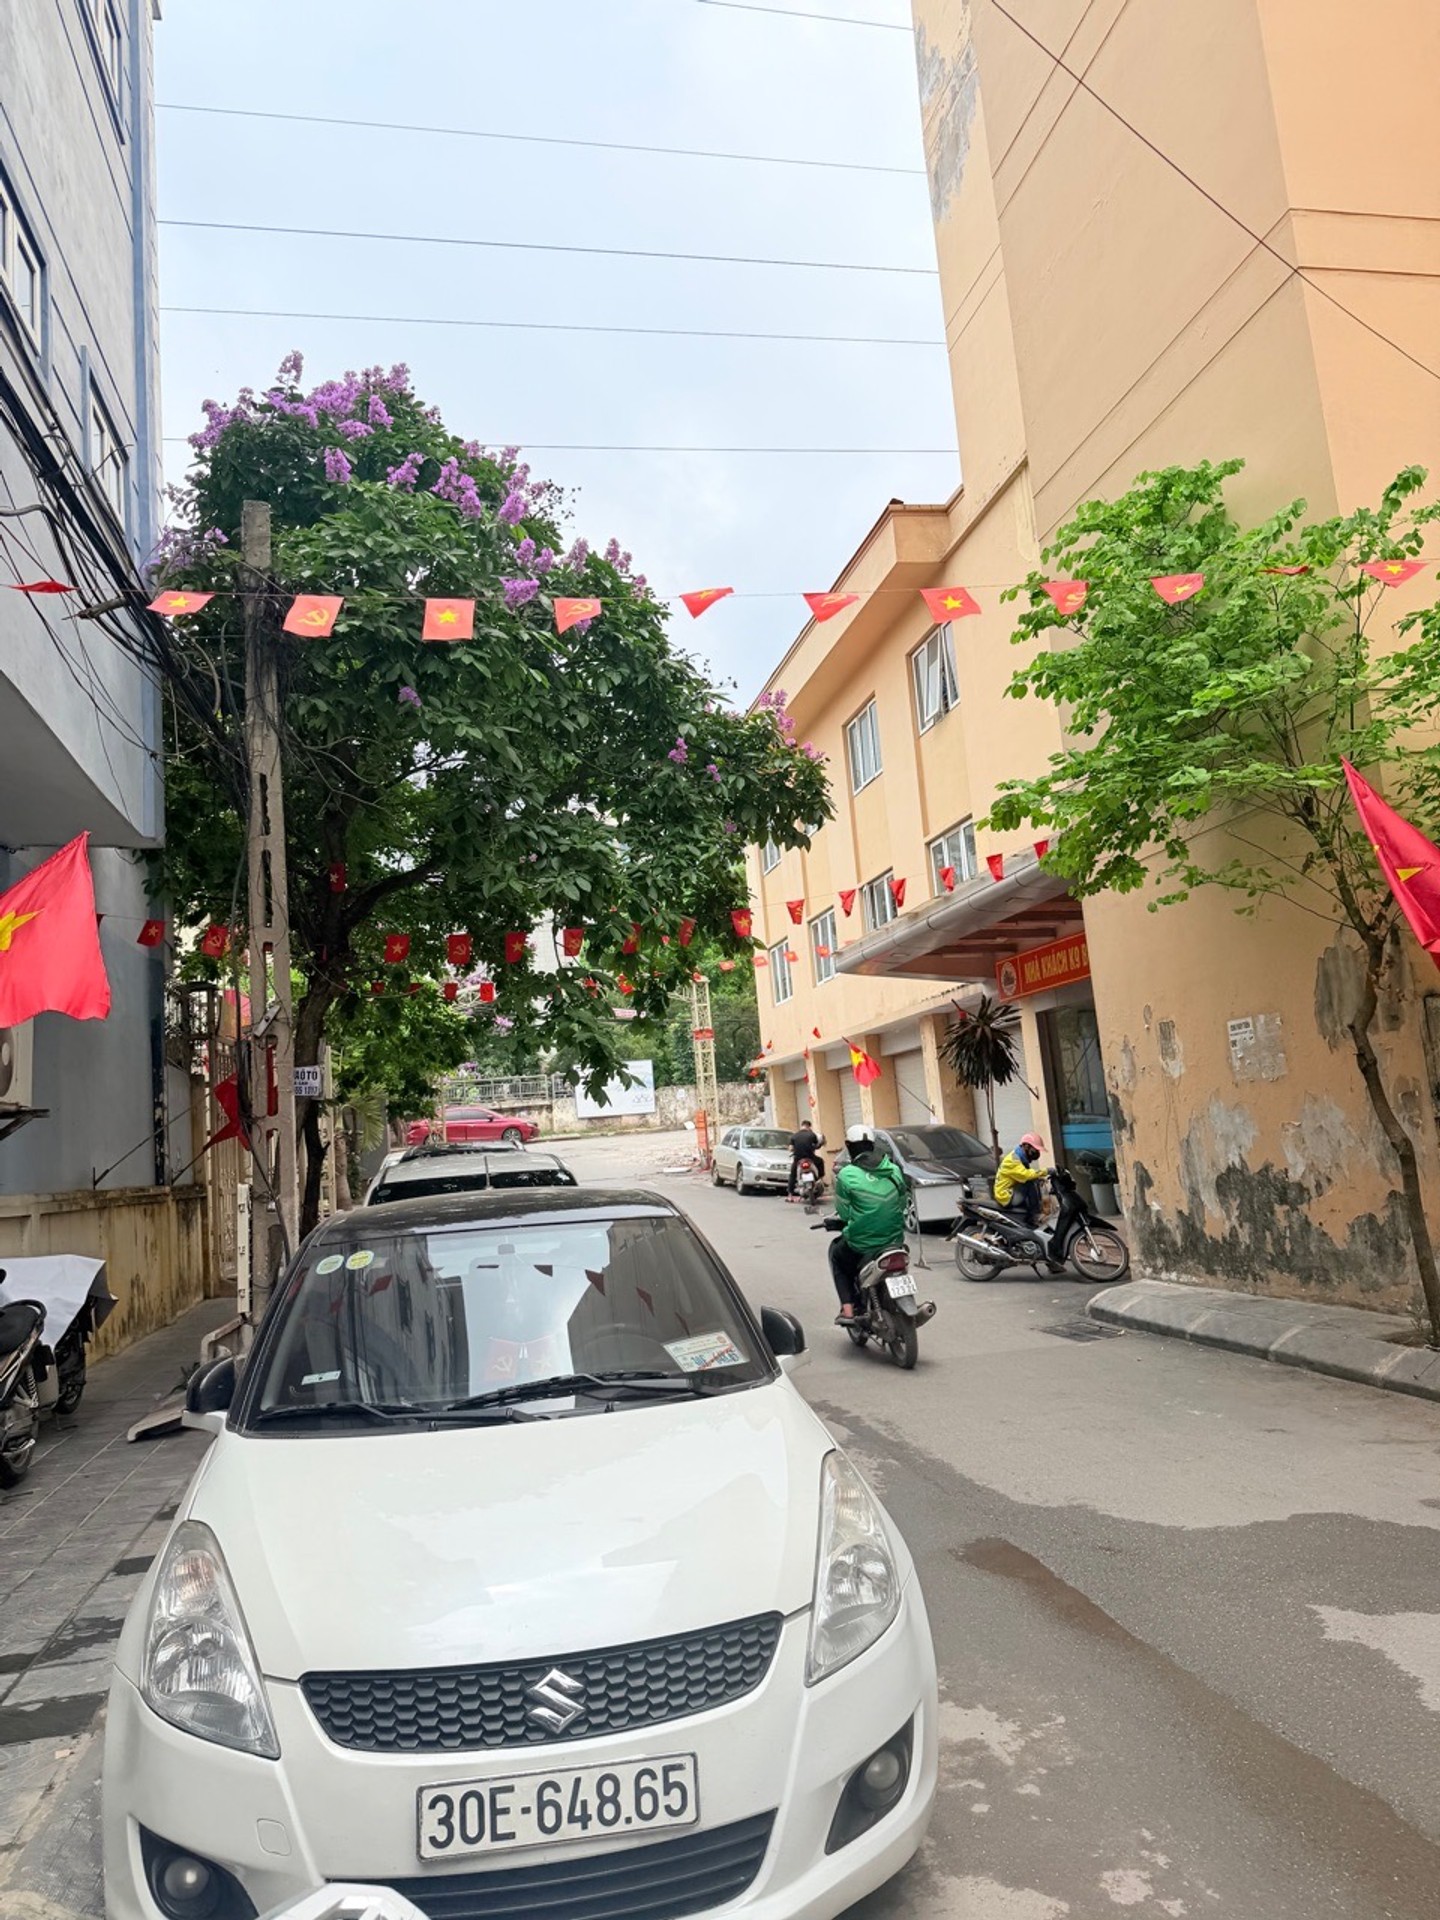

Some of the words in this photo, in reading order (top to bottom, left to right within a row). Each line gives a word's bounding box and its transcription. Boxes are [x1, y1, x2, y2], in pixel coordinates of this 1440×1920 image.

[1024, 955, 1041, 984] NHÀ
[1041, 949, 1068, 979] KHÁCH
[1068, 946, 1081, 970] K9
[428, 1763, 688, 1849] 30E-648.65
